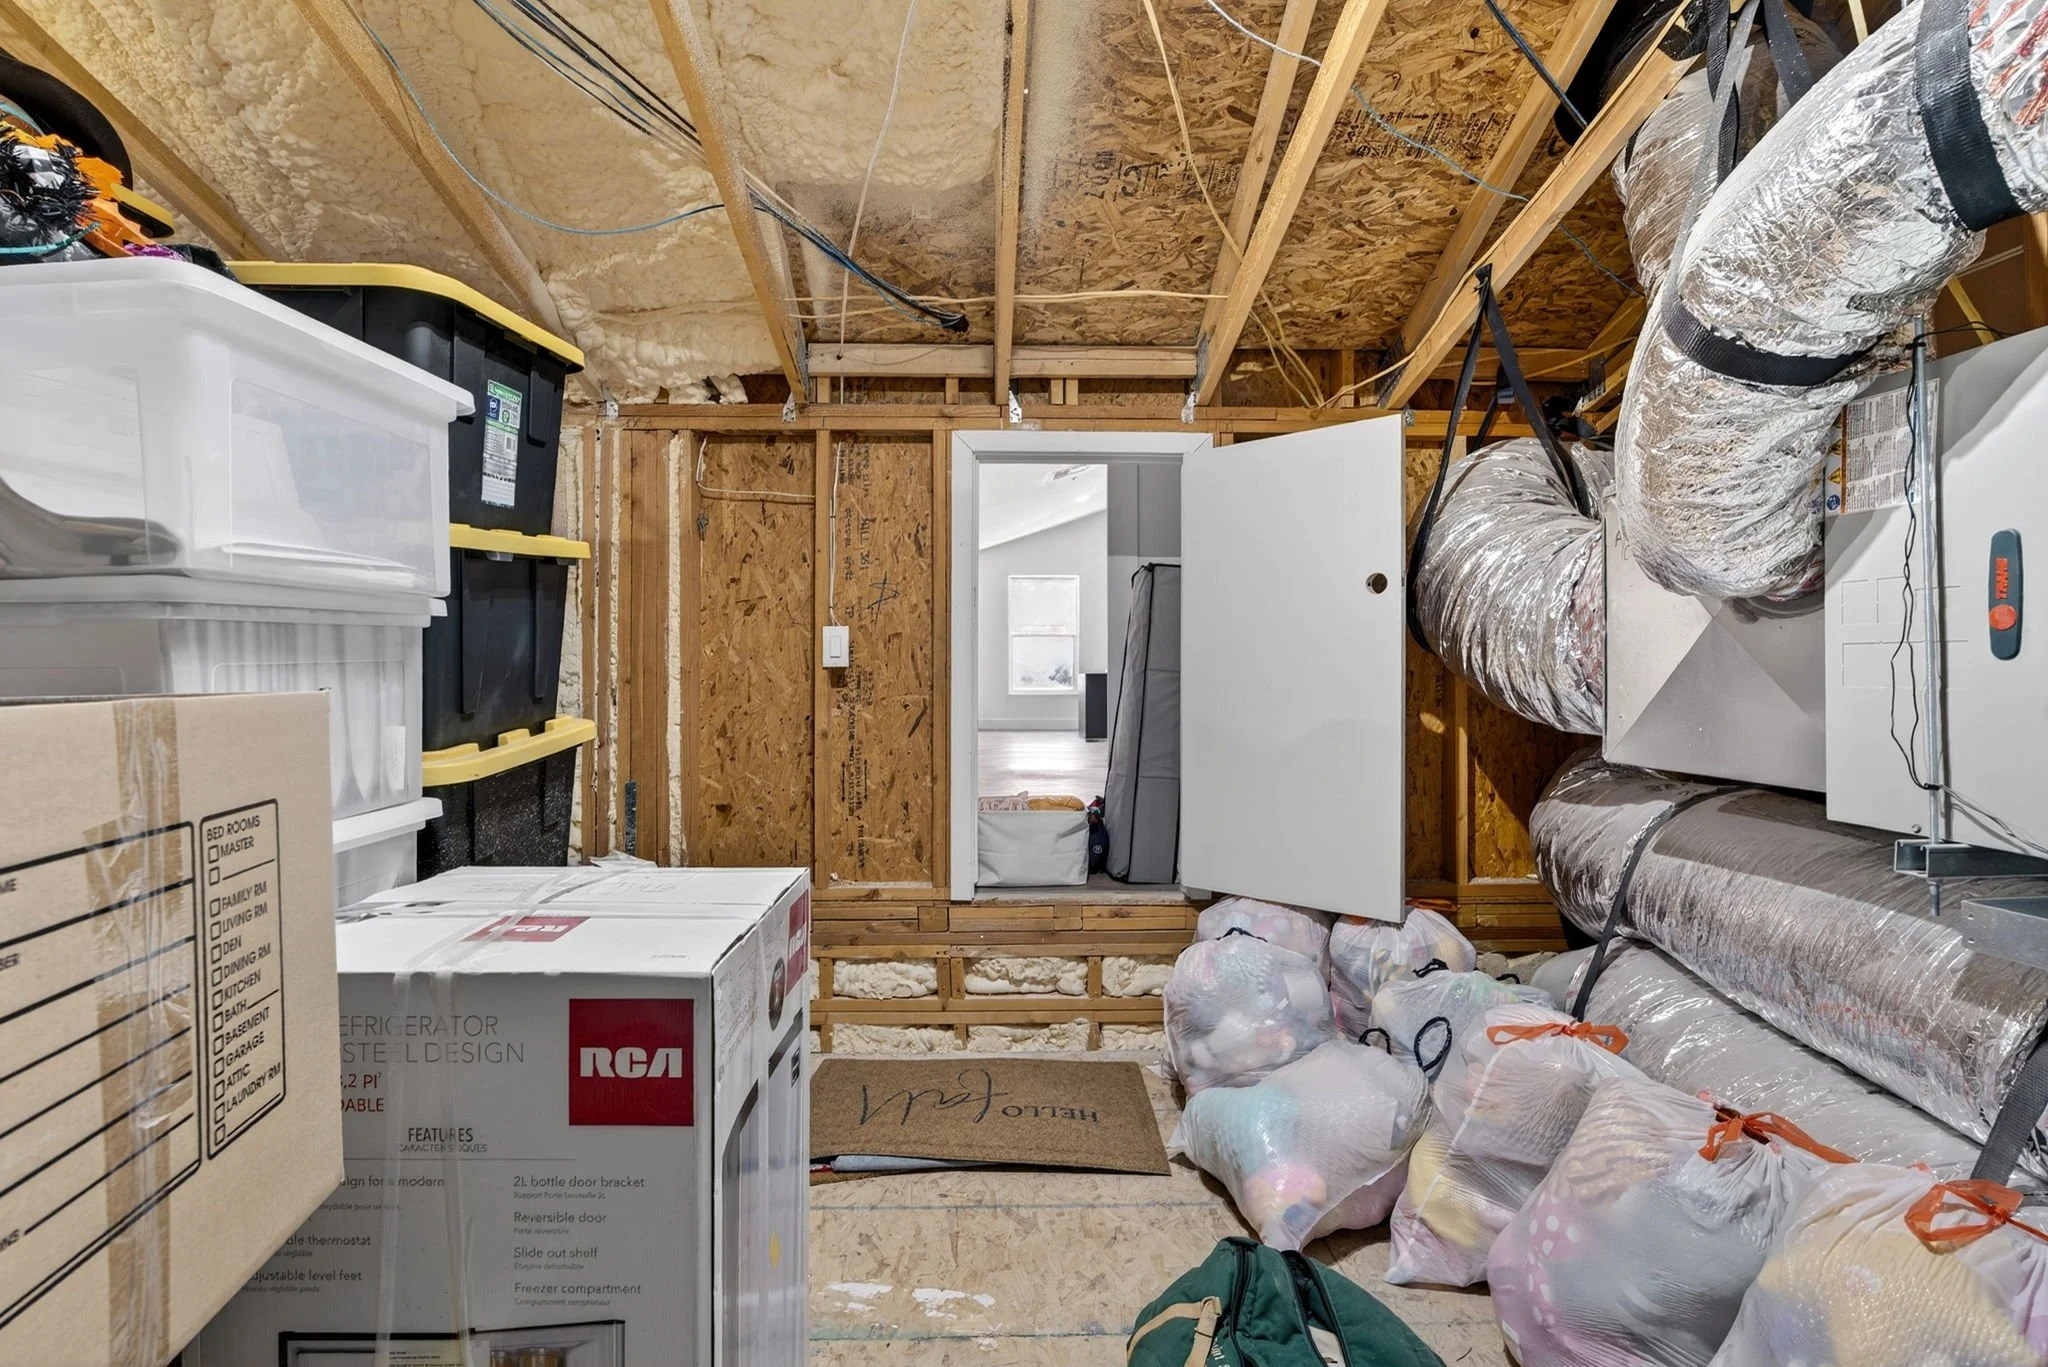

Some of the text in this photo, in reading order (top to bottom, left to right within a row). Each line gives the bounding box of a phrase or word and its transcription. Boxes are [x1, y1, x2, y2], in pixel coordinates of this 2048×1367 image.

[206, 815, 260, 842] BED ROOMS
[220, 836, 255, 858] MASTER
[221, 881, 267, 911] FAMILY RM
[222, 902, 268, 933] LIVING RM
[222, 935, 242, 956] DEN
[223, 943, 271, 979] DINING RM
[224, 969, 261, 1001] KITCHEN
[224, 999, 247, 1023] BATH
[225, 1007, 270, 1045] BASEMENT
[226, 1032, 265, 1066] GARAGE
[424, 1042, 525, 1064] DESIGN
[579, 1047, 683, 1079] RCA
[225, 1063, 251, 1090] ATTIC
[226, 1062, 281, 1113] LAUNDRY RM
[1002, 1104, 1098, 1123] HELLO
[407, 1127, 474, 1143] FEATURES
[368, 1174, 385, 1187] for
[398, 1175, 445, 1187] modern
[513, 1175, 645, 1188] 2L bottle door bracket
[513, 1211, 607, 1223] Reversible door
[307, 1234, 371, 1246] thermostat
[513, 1246, 598, 1258] Slide out shelf
[308, 1270, 336, 1281] level
[338, 1270, 362, 1281] feet
[513, 1282, 642, 1297] Freezer compartment
